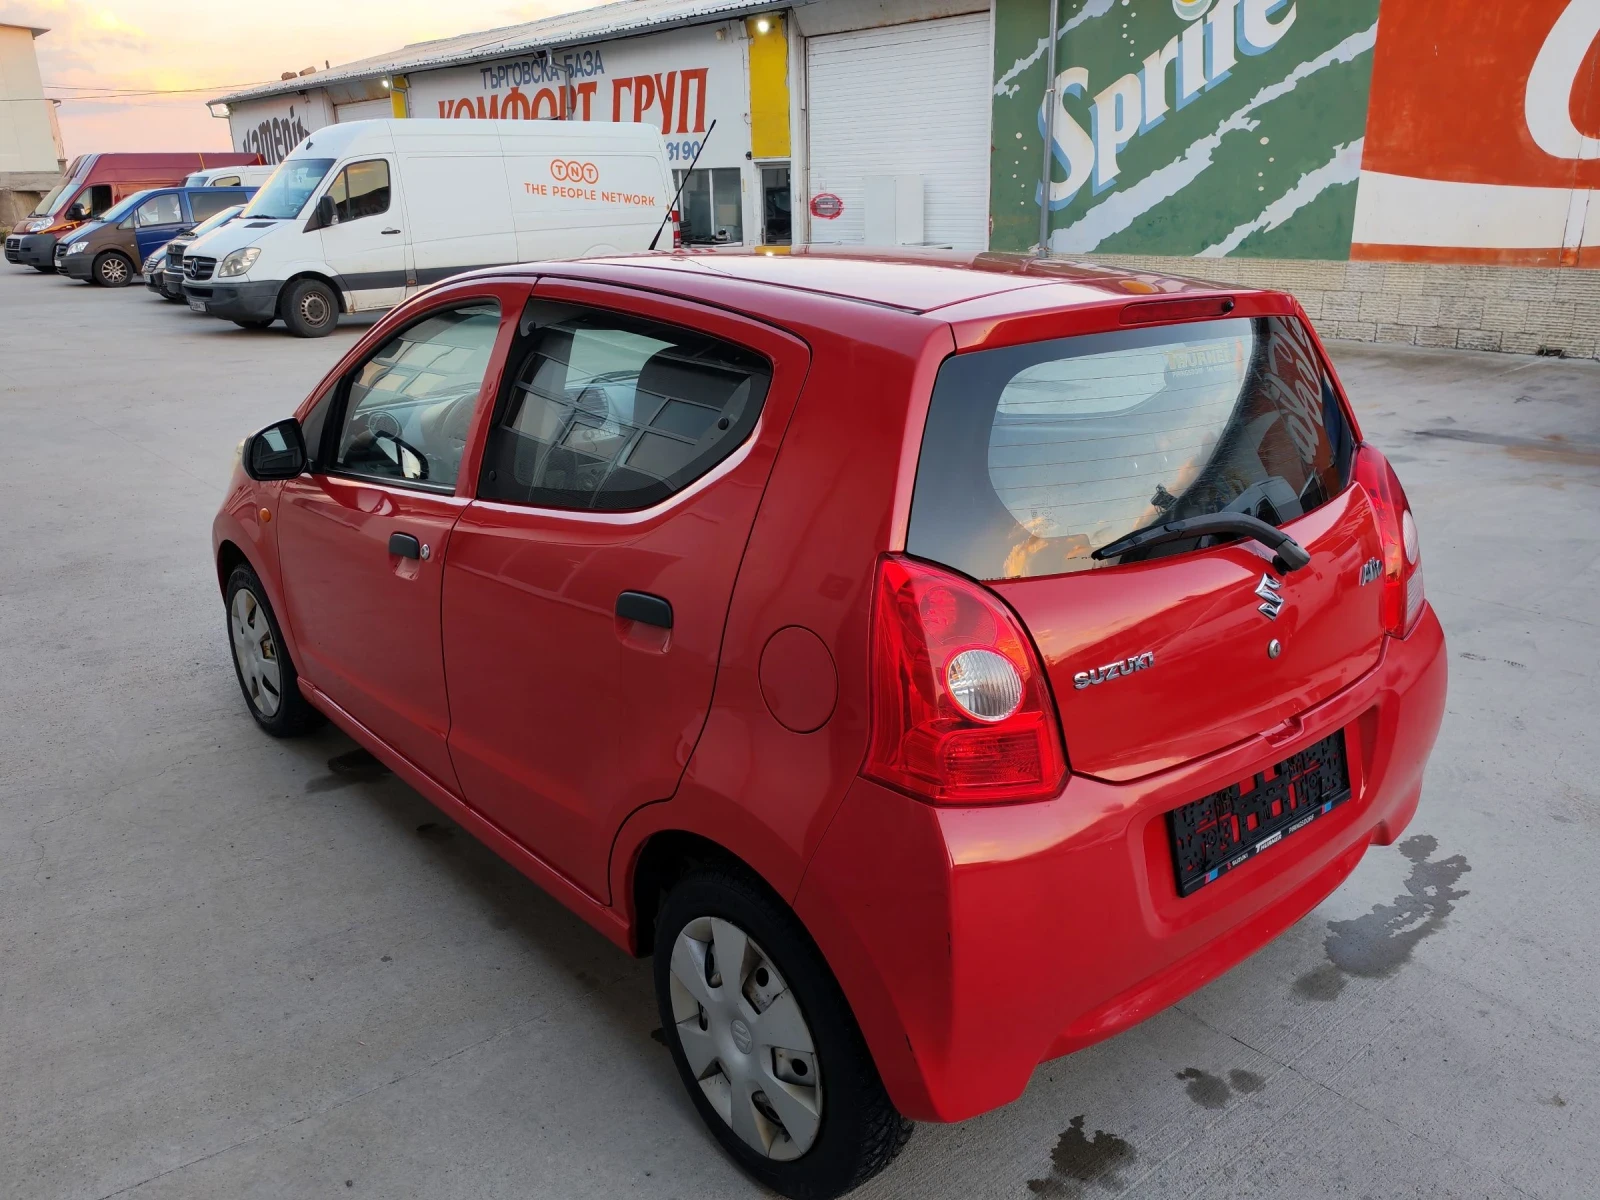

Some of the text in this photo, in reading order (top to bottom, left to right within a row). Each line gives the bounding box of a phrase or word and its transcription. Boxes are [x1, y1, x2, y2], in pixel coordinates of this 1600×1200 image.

[564, 50, 605, 79] БАЗА
[612, 67, 709, 135] ГРУП
[553, 162, 596, 181] TNT
[524, 182, 656, 207] THE PEOPLE NETWORK
[1073, 651, 1154, 690] SUZUKI
